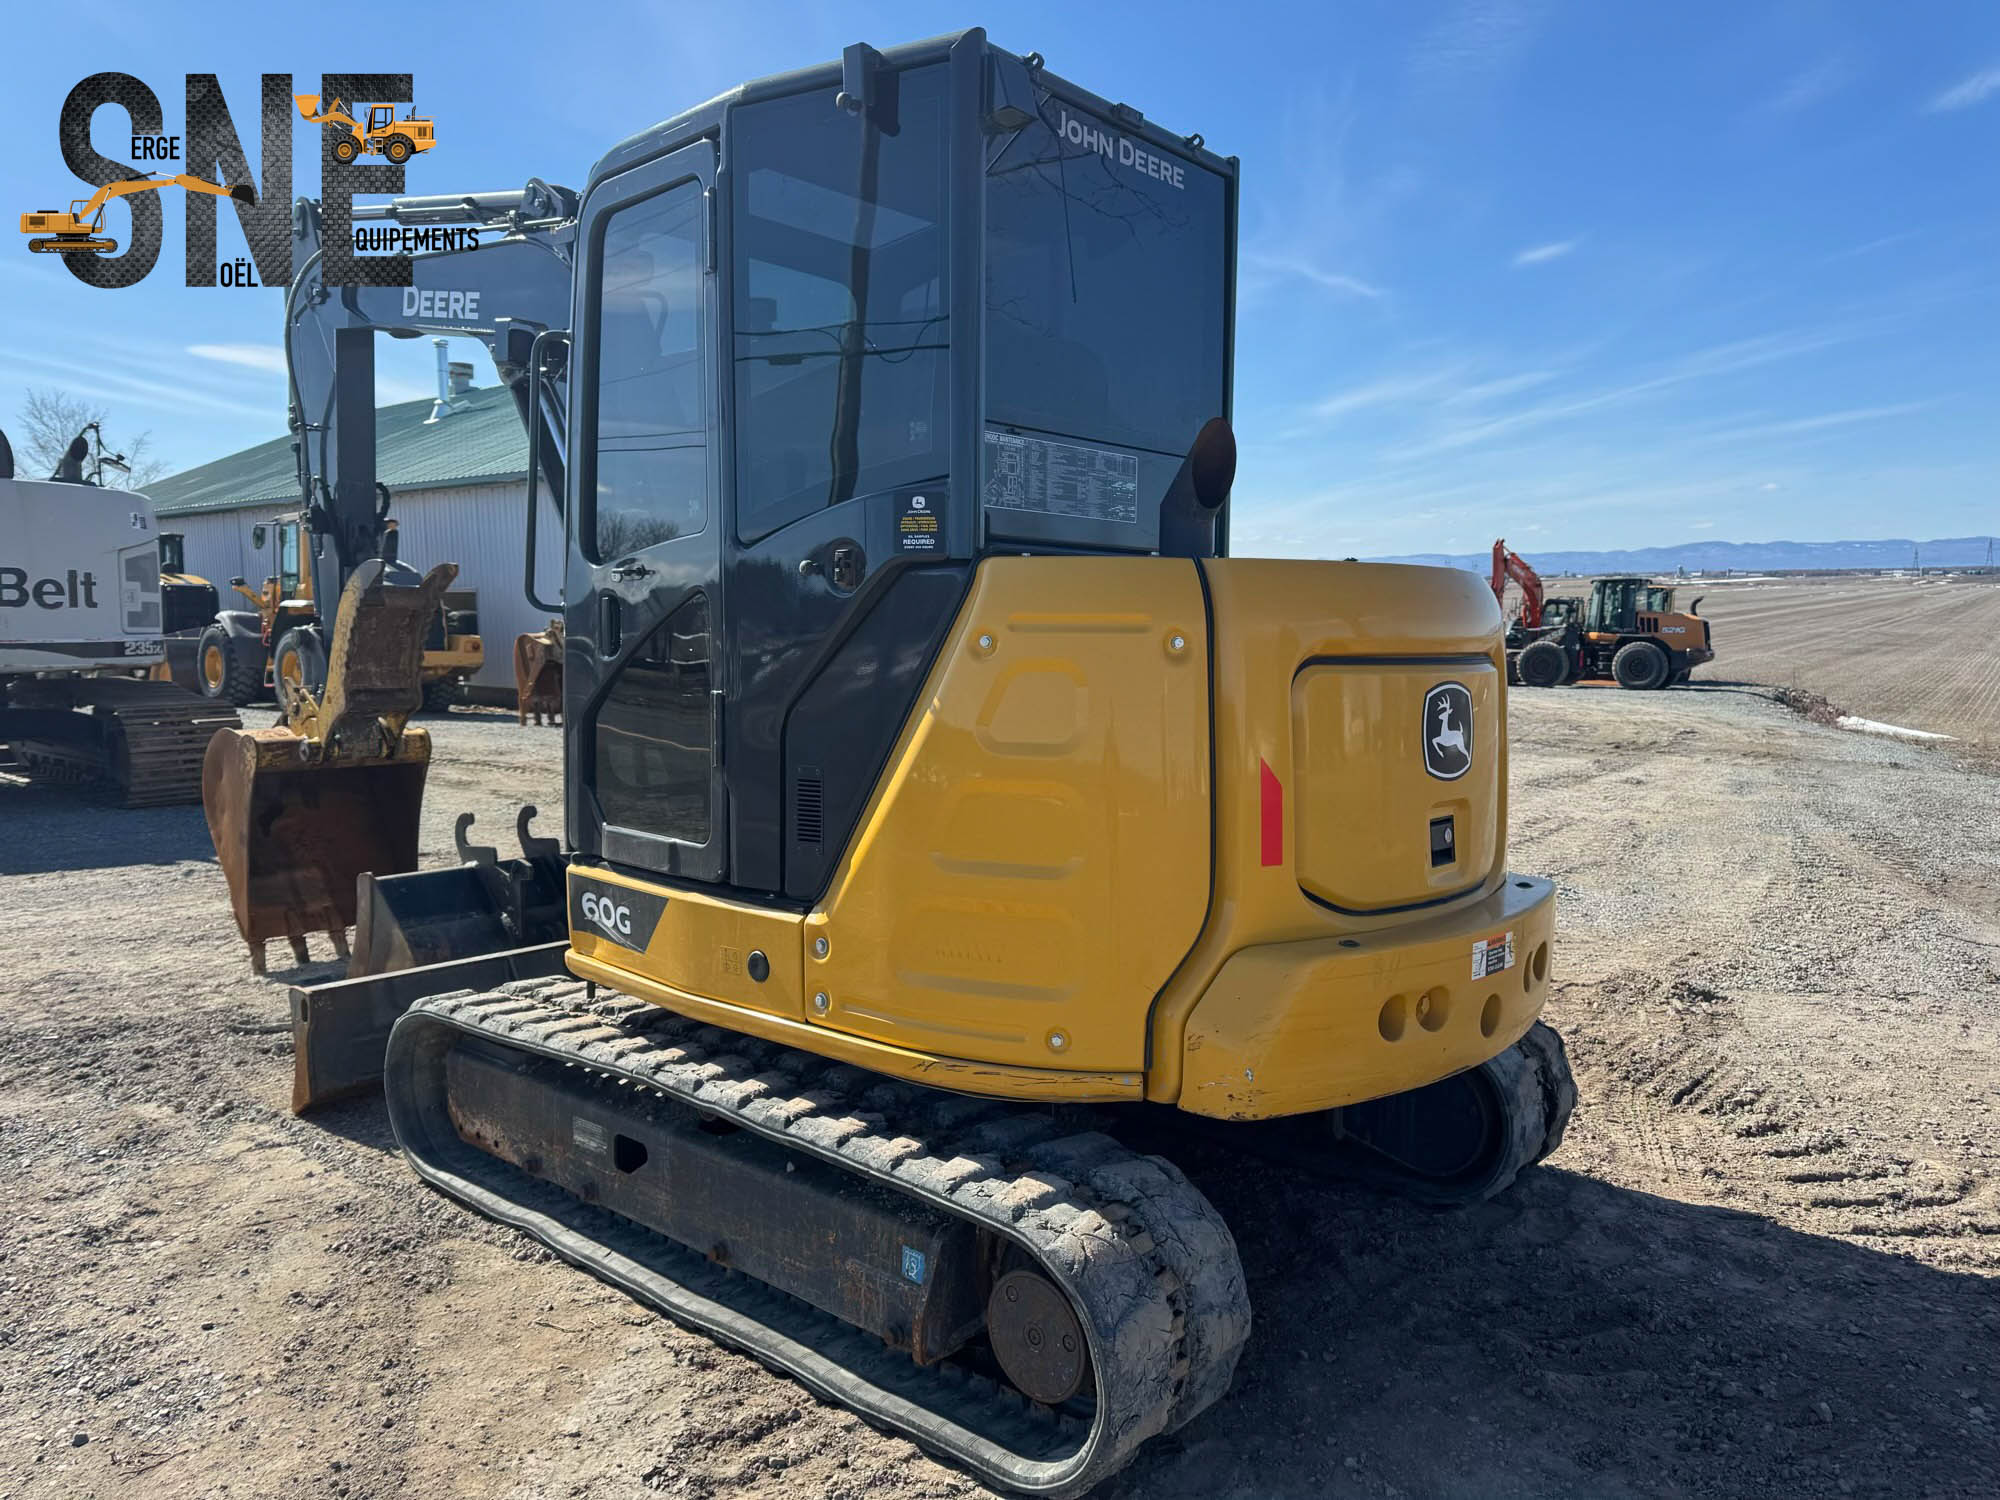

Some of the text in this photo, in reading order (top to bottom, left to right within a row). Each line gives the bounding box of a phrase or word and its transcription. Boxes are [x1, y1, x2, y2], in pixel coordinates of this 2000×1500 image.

[1057, 110, 1185, 190] JOHN DEERE
[402, 285, 481, 320] DEERE
[0, 567, 98, 610] Belt
[581, 892, 631, 935] 60G
